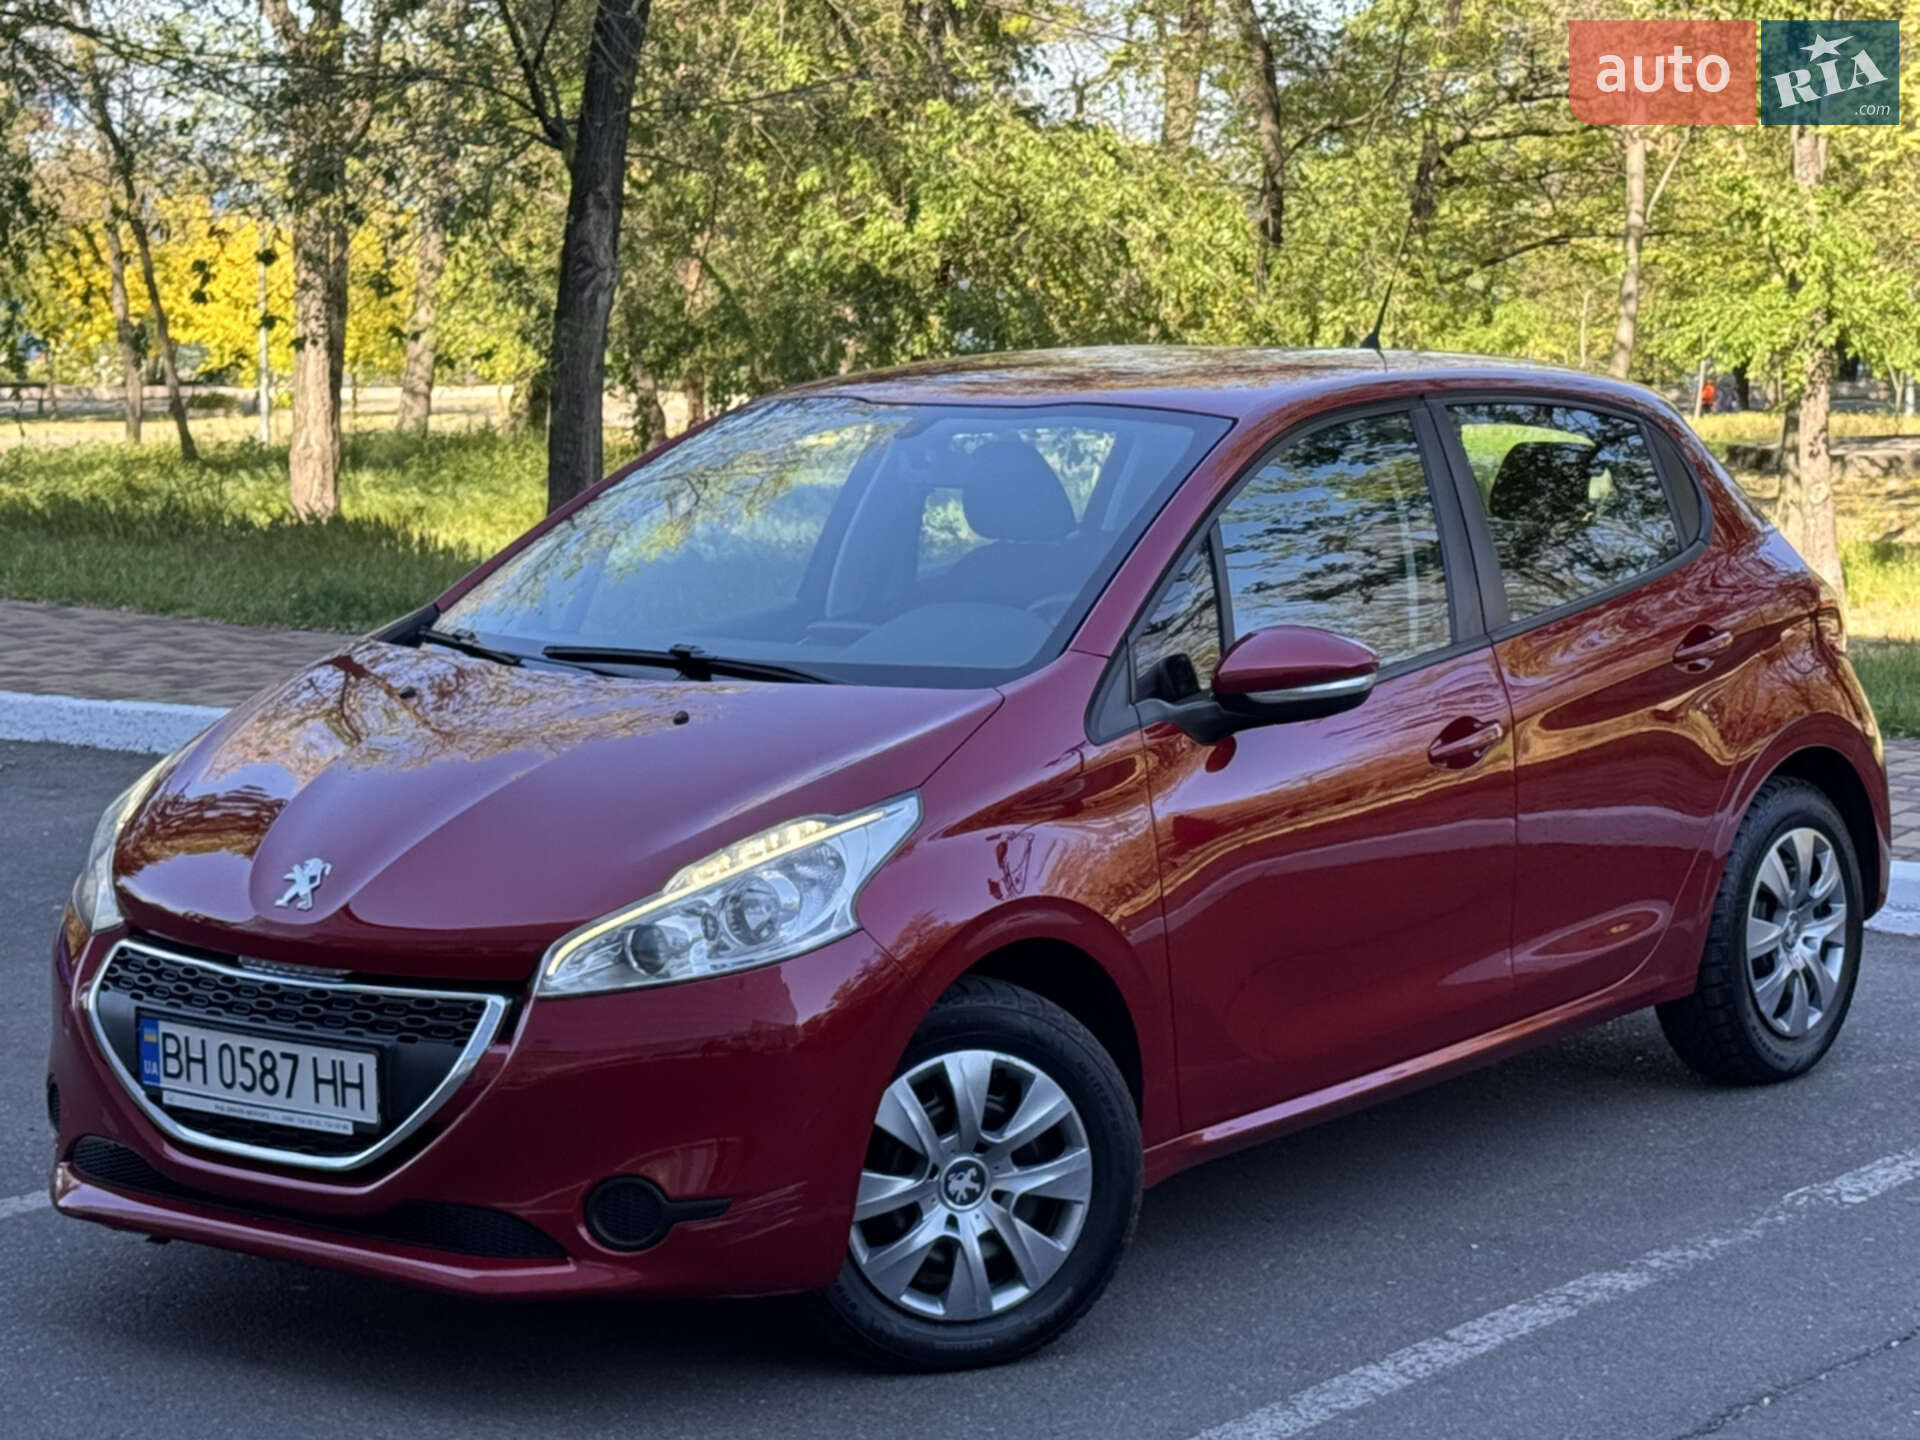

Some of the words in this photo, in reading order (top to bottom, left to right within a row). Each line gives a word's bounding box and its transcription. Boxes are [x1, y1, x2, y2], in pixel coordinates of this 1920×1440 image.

[143, 1060, 159, 1076] UA
[161, 1032, 208, 1085] BH
[217, 1043, 299, 1099] 0587
[312, 1056, 366, 1111] HH
